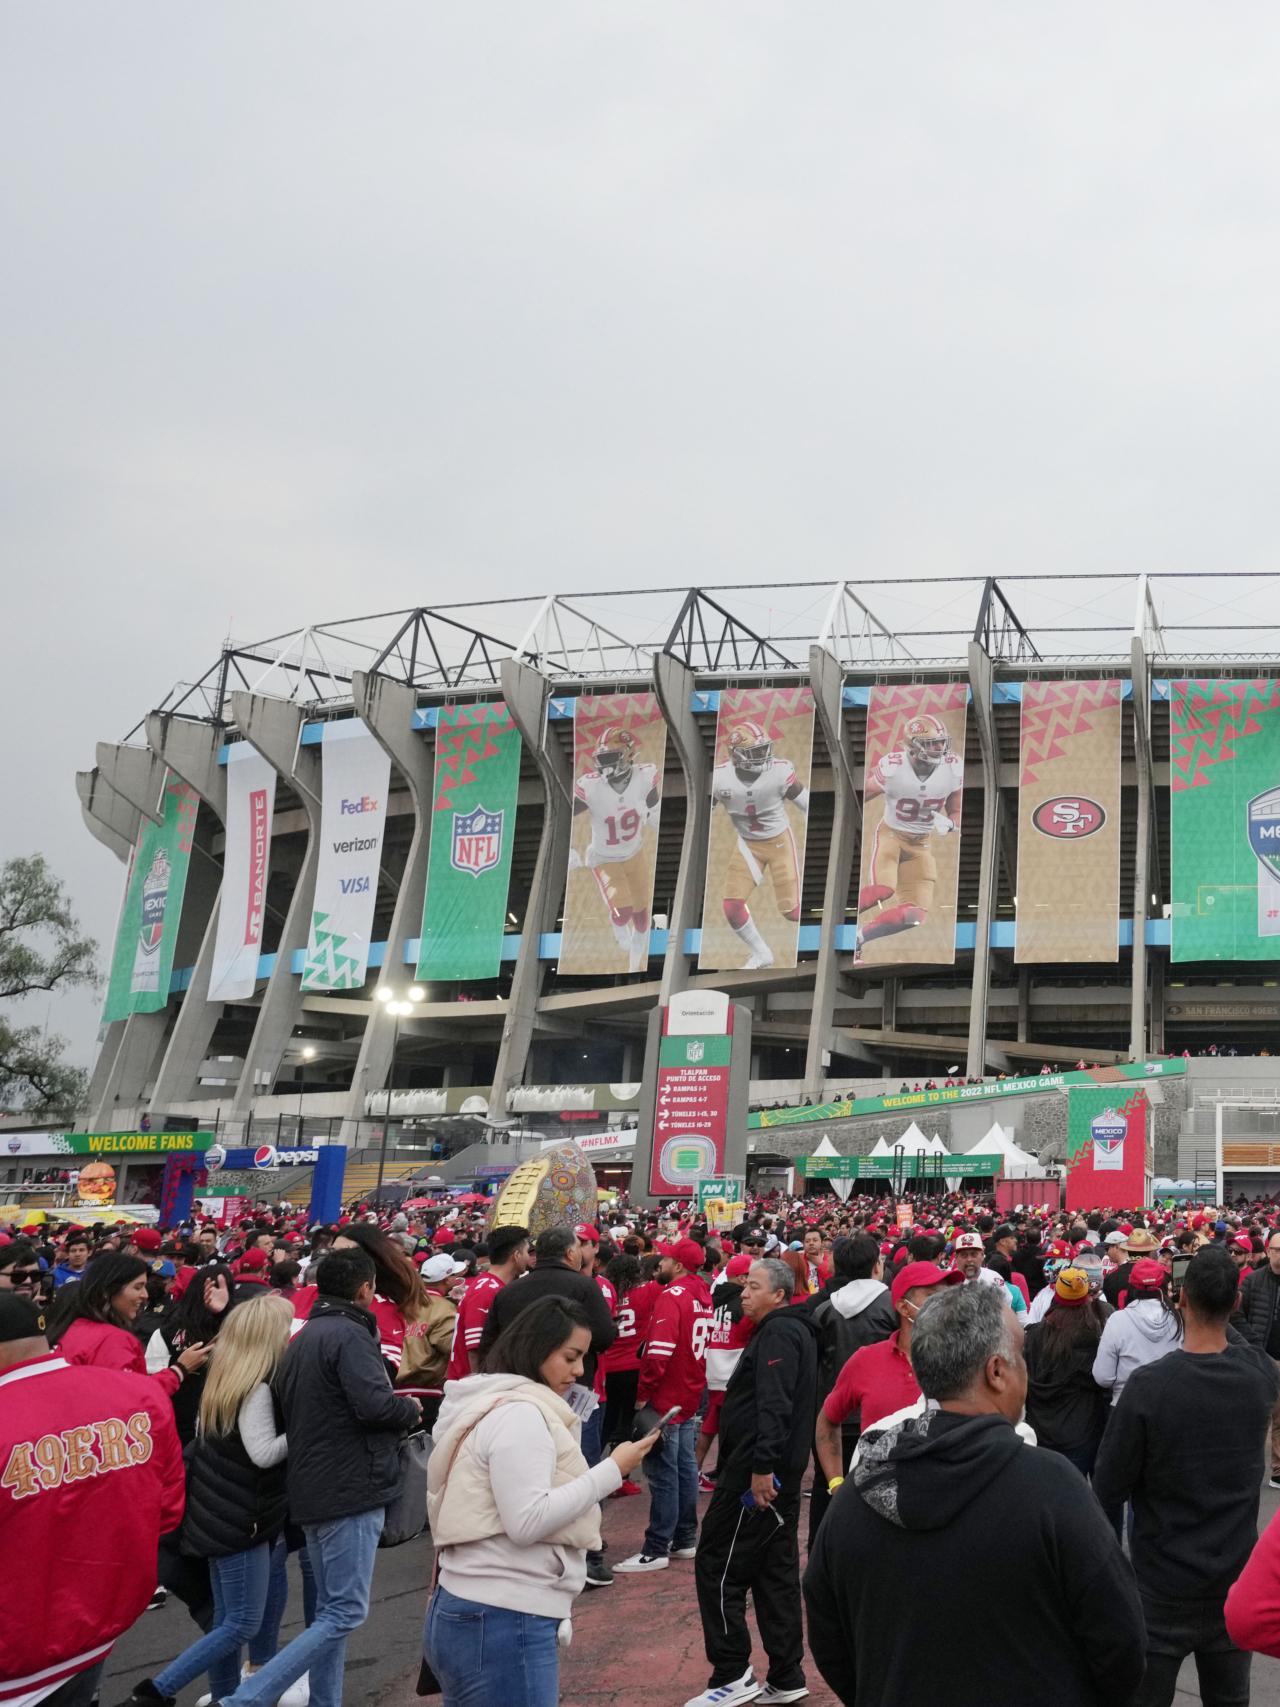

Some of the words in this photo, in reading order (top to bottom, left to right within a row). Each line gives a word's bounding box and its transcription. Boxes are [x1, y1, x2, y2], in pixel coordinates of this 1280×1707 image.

[340, 796, 378, 815] FedEx
[604, 808, 641, 846] 19
[744, 804, 764, 833] 1
[254, 795, 264, 906] BANORTE
[333, 837, 377, 854] verizon
[457, 835, 497, 867] NFL
[340, 876, 370, 894] VISA
[882, 1094, 926, 1108] WELCOME
[928, 1092, 940, 1102] TO
[942, 1090, 959, 1100] THE
[960, 1088, 982, 1097] 2022
[984, 1085, 1001, 1095] NFL
[1003, 1080, 1037, 1092] MEXICO
[1039, 1076, 1065, 1088] GAME
[88, 1136, 157, 1151] WELCOME
[160, 1135, 194, 1150] FANS
[581, 1135, 619, 1148] #NFLMX
[273, 1148, 319, 1166] pepsi
[1, 1412, 153, 1500] 49ERS
